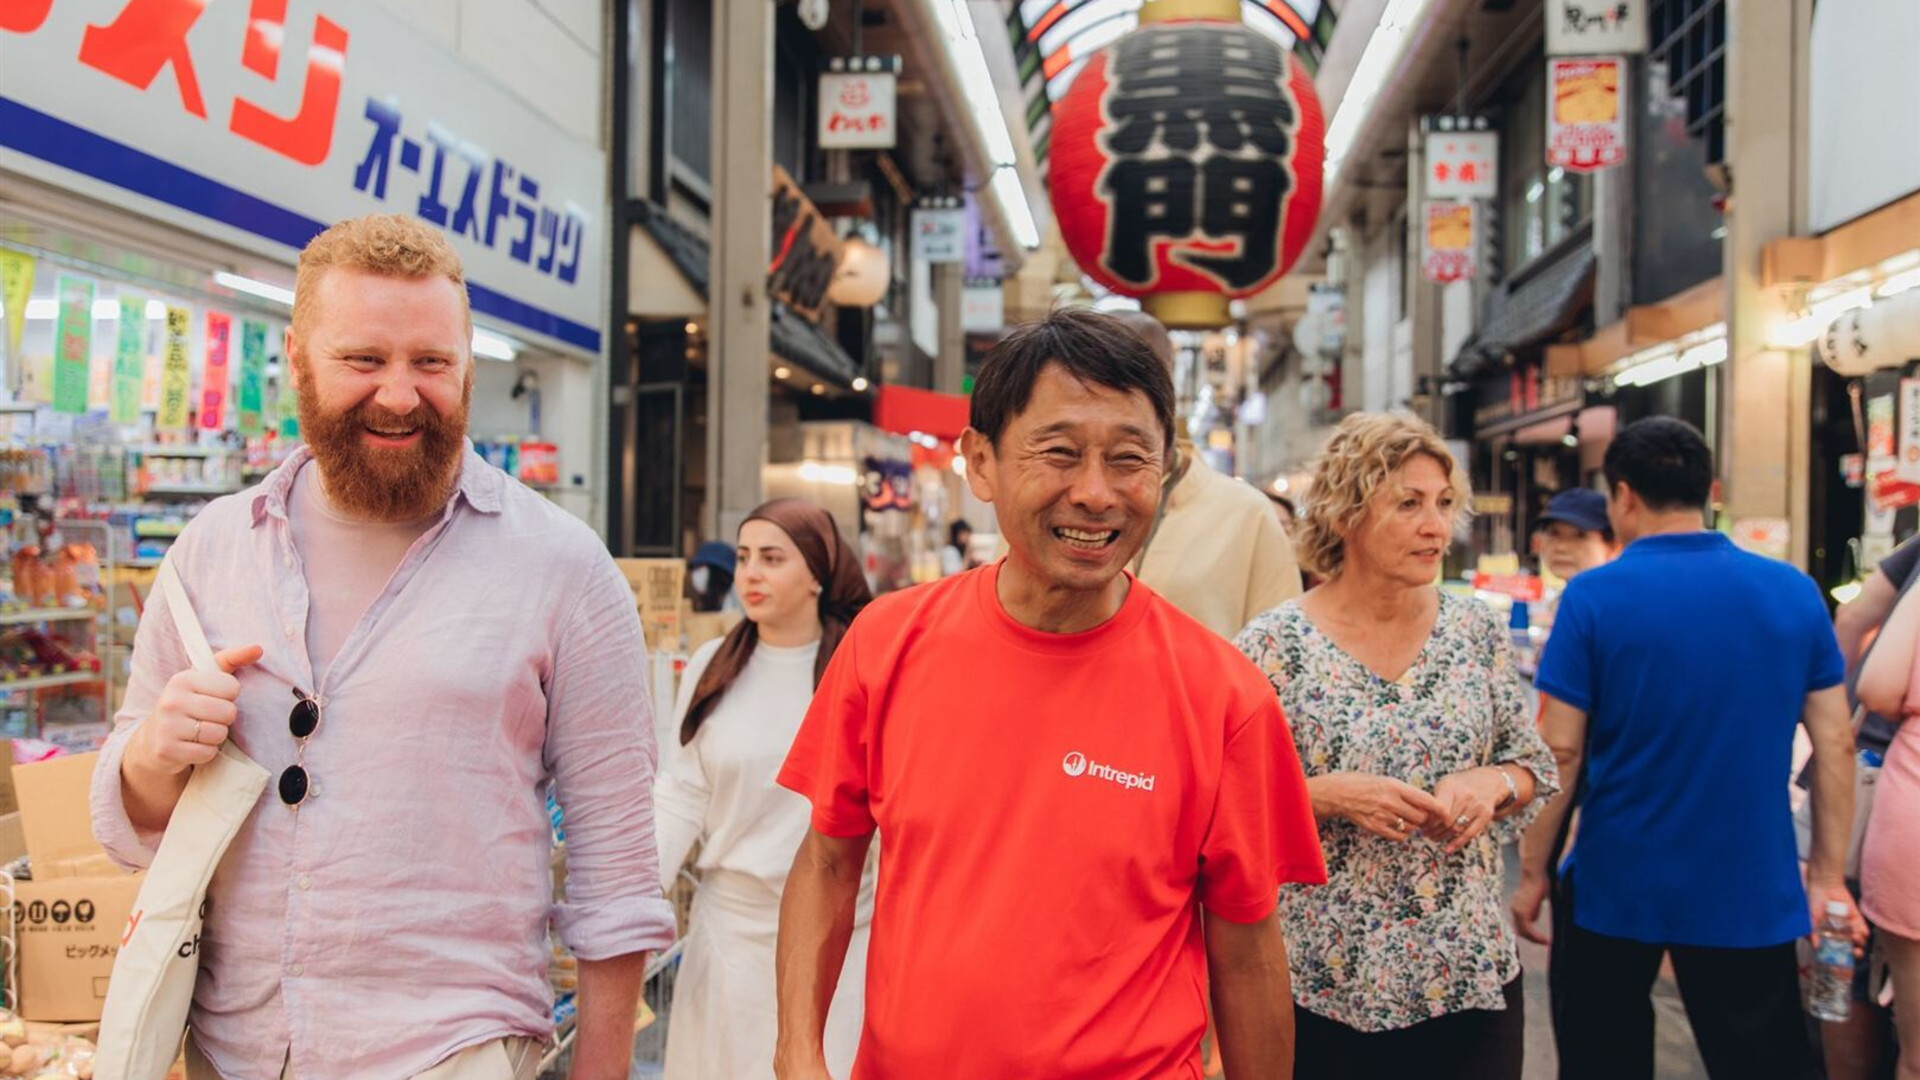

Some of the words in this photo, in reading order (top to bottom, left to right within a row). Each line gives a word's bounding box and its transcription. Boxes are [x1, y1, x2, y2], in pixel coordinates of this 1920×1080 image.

[0, 0, 349, 167] スリ
[1105, 27, 1293, 289] 黒門
[1088, 760, 1155, 791] Intrepid
